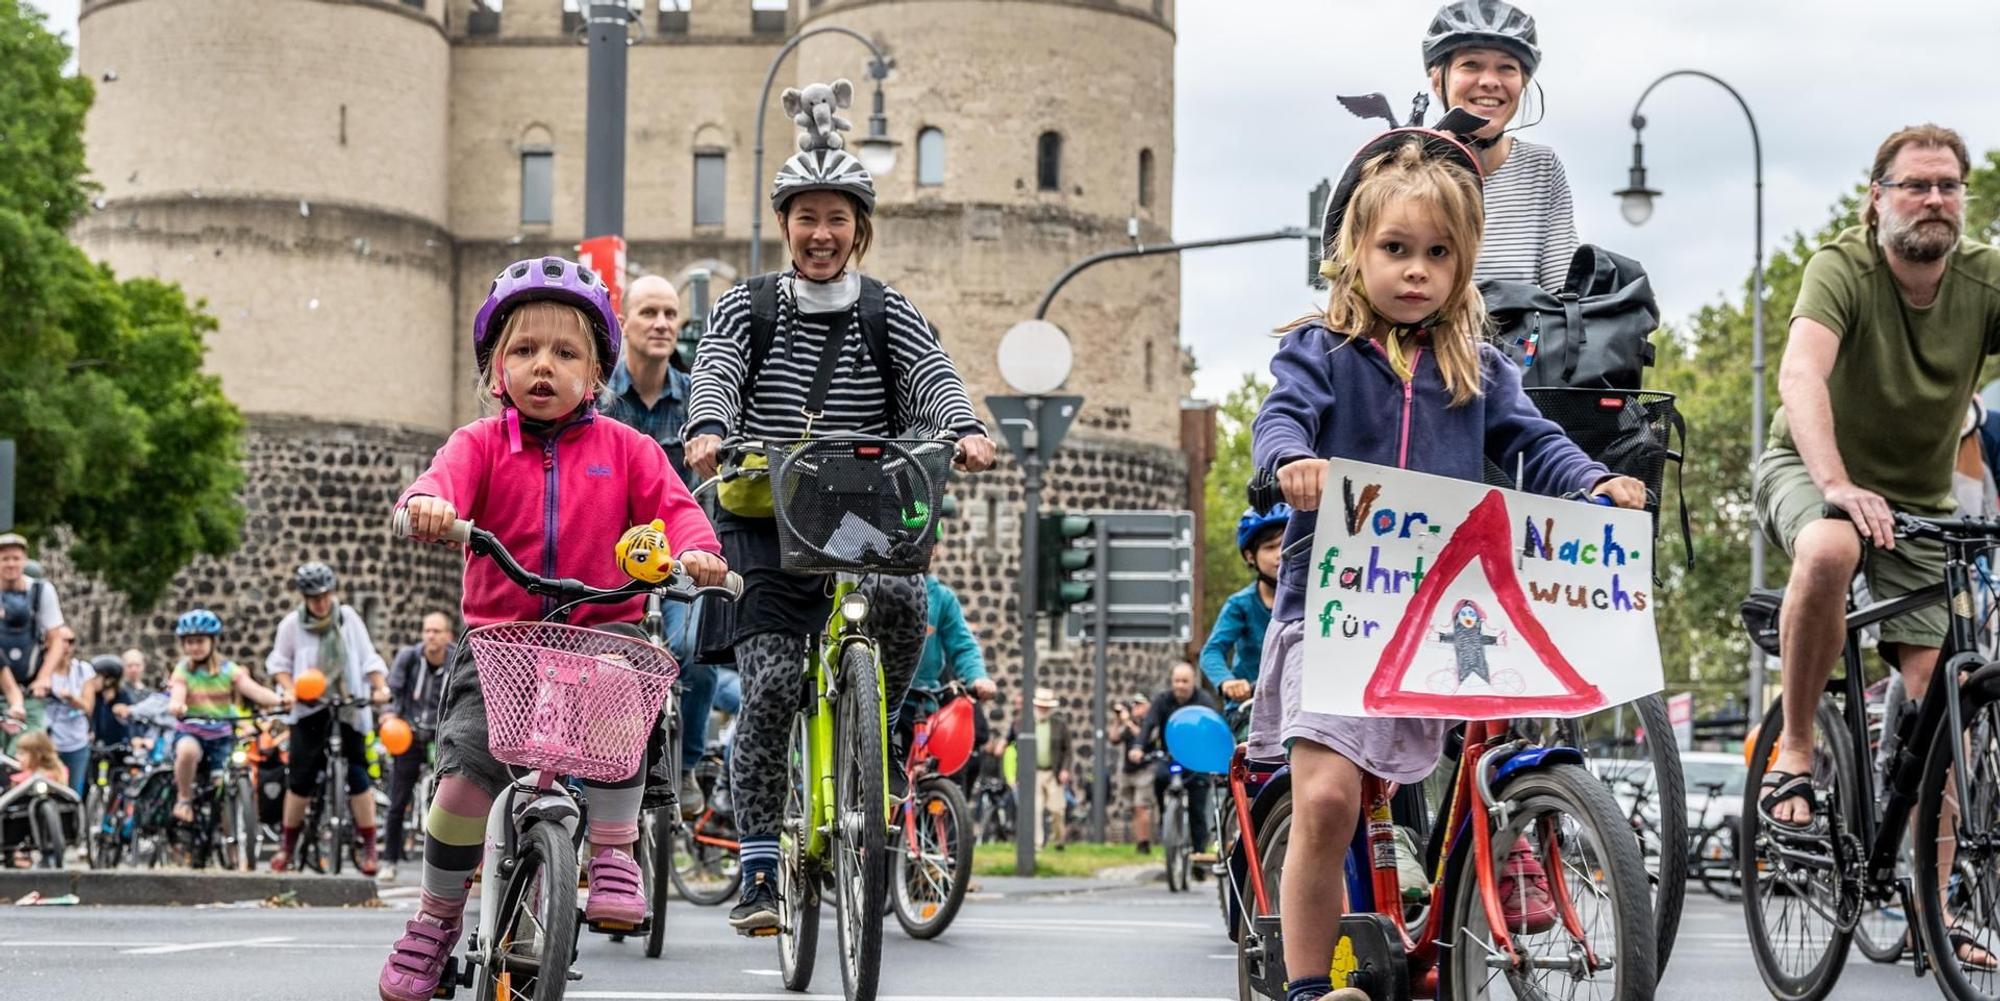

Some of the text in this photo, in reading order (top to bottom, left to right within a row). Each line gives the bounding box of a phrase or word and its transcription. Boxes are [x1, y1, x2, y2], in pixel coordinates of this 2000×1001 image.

[1342, 475, 1442, 539] Vor-
[1317, 546, 1424, 594] fahrt
[1528, 573, 1647, 612] wuchs
[1318, 599, 1380, 638] für
